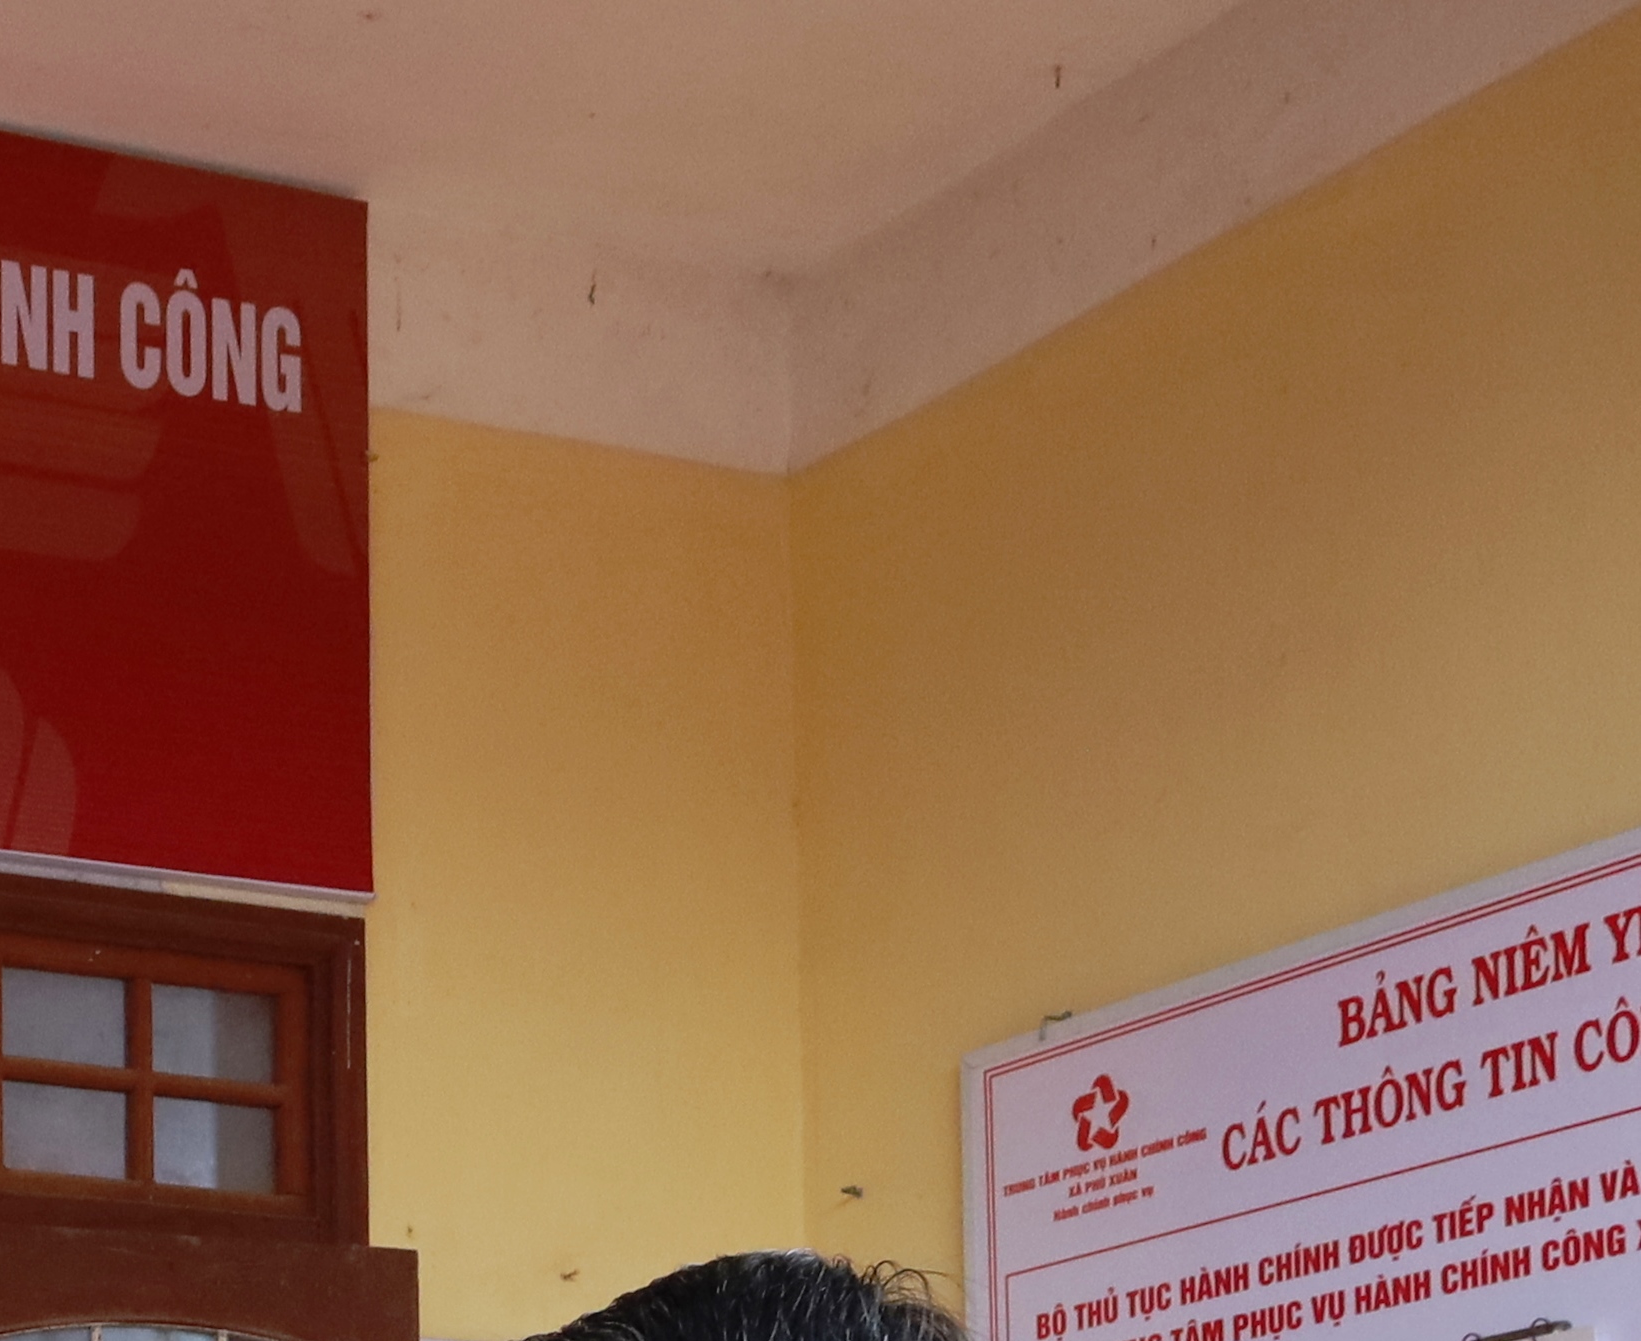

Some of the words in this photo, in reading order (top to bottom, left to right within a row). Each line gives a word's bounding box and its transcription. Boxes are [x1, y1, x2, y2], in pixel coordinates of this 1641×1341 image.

[119, 268, 302, 413] CÔNG
[1337, 970, 1457, 1047] BẢNG
[1471, 924, 1591, 1006] NIÊM
[1222, 1101, 1301, 1171] CÁC
[1313, 1059, 1467, 1145] THÔNG
[1480, 1031, 1558, 1099] TIN
[1573, 995, 1641, 1072] CÔ
[1036, 1302, 1067, 1341] BỘ
[1074, 1286, 1118, 1330] THỦ
[1126, 1282, 1172, 1321] TỤC
[1180, 1262, 1249, 1305] HÀNH
[1258, 1240, 1340, 1285] CHÍNH
[1348, 1220, 1423, 1262] ĐƯỢC
[1432, 1194, 1494, 1244] TIẾP
[1504, 1176, 1590, 1227] NHẬN
[1599, 1159, 1641, 1203] VÀ
[1311, 1290, 1346, 1327] VỤ
[1354, 1269, 1431, 1315] HÀNH
[1440, 1246, 1531, 1295] CHÍNH
[1541, 1224, 1627, 1272] CÔNG
